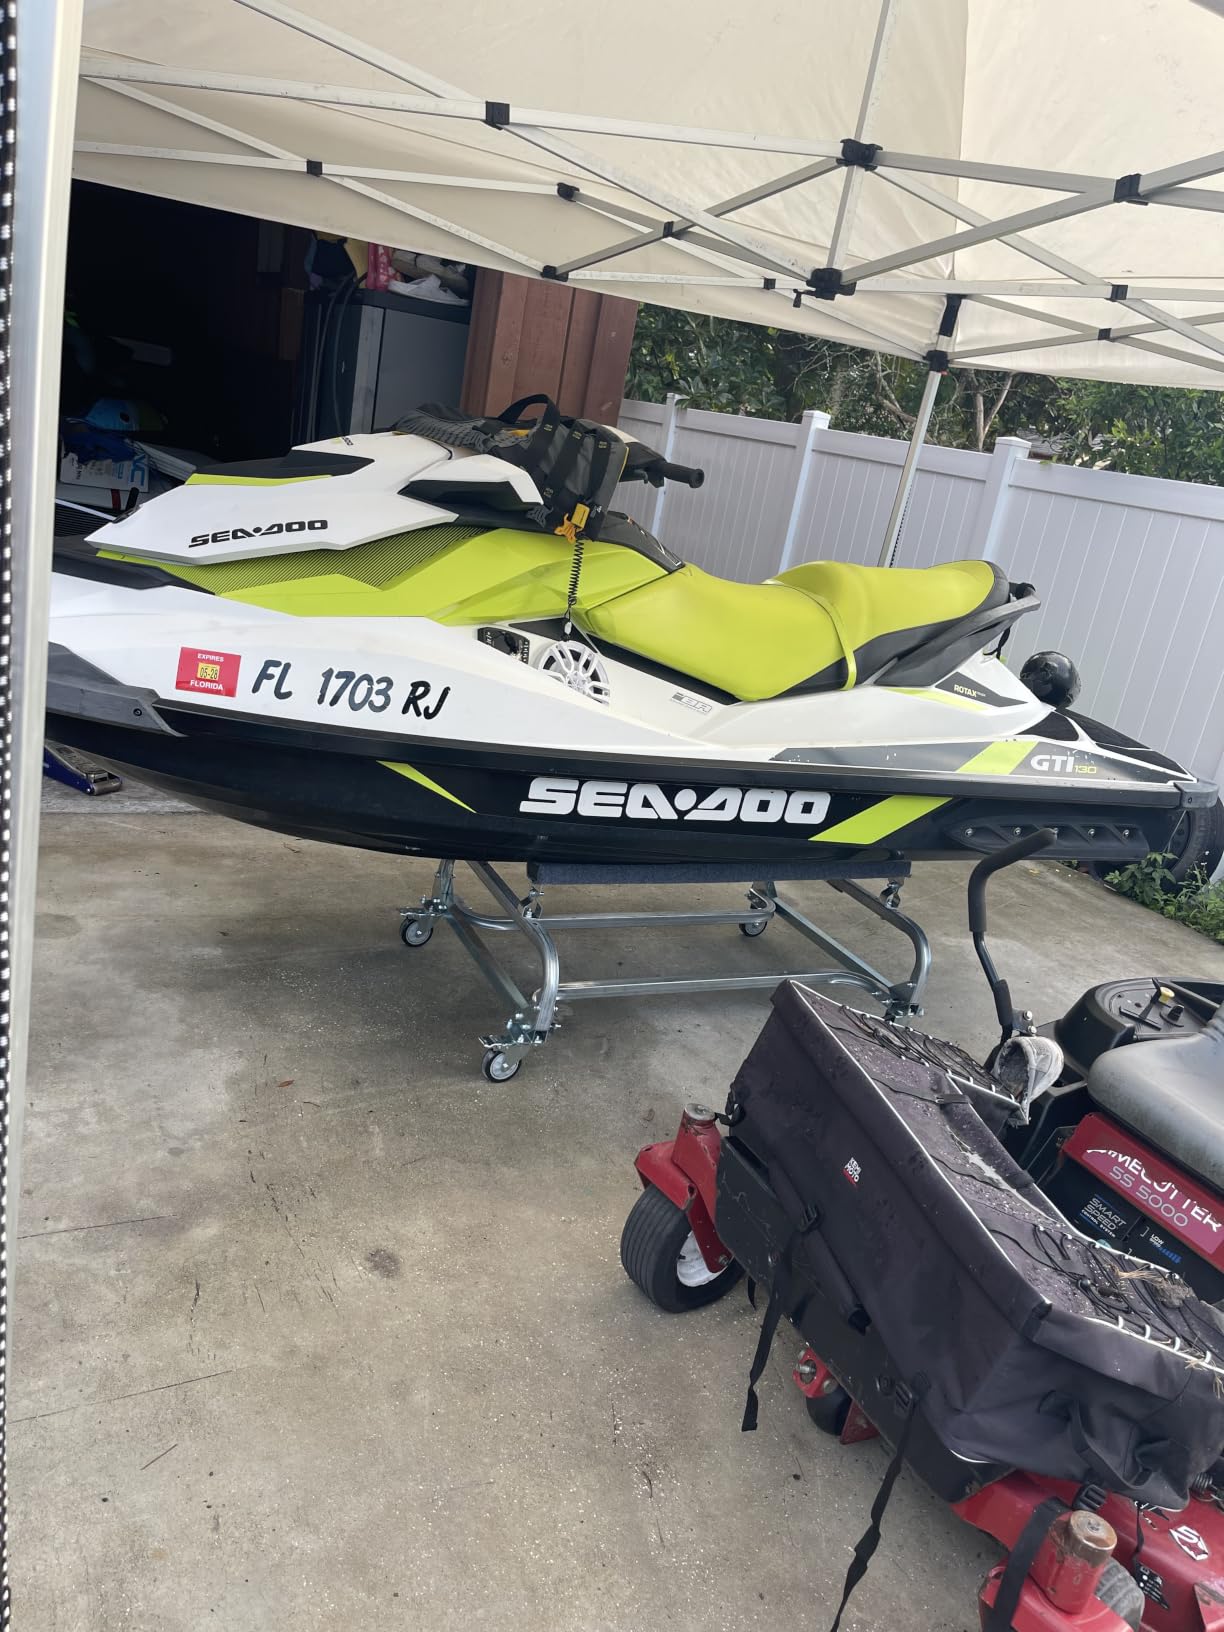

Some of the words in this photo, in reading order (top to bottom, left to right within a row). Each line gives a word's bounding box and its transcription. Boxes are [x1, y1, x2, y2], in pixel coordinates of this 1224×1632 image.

[197, 653, 225, 663] EXPIRES
[190, 679, 224, 691] FLORIDA
[251, 659, 293, 700] FL
[317, 668, 394, 713] 1703
[401, 680, 451, 720] RJ
[953, 684, 977, 697] ROTAX
[1109, 1165, 1136, 1188] SS
[1136, 1185, 1189, 1227] 5000
[1081, 1209, 1099, 1225] CONTROL
[1084, 1204, 1117, 1230] SPEED
[1089, 1198, 1127, 1226] SMART
